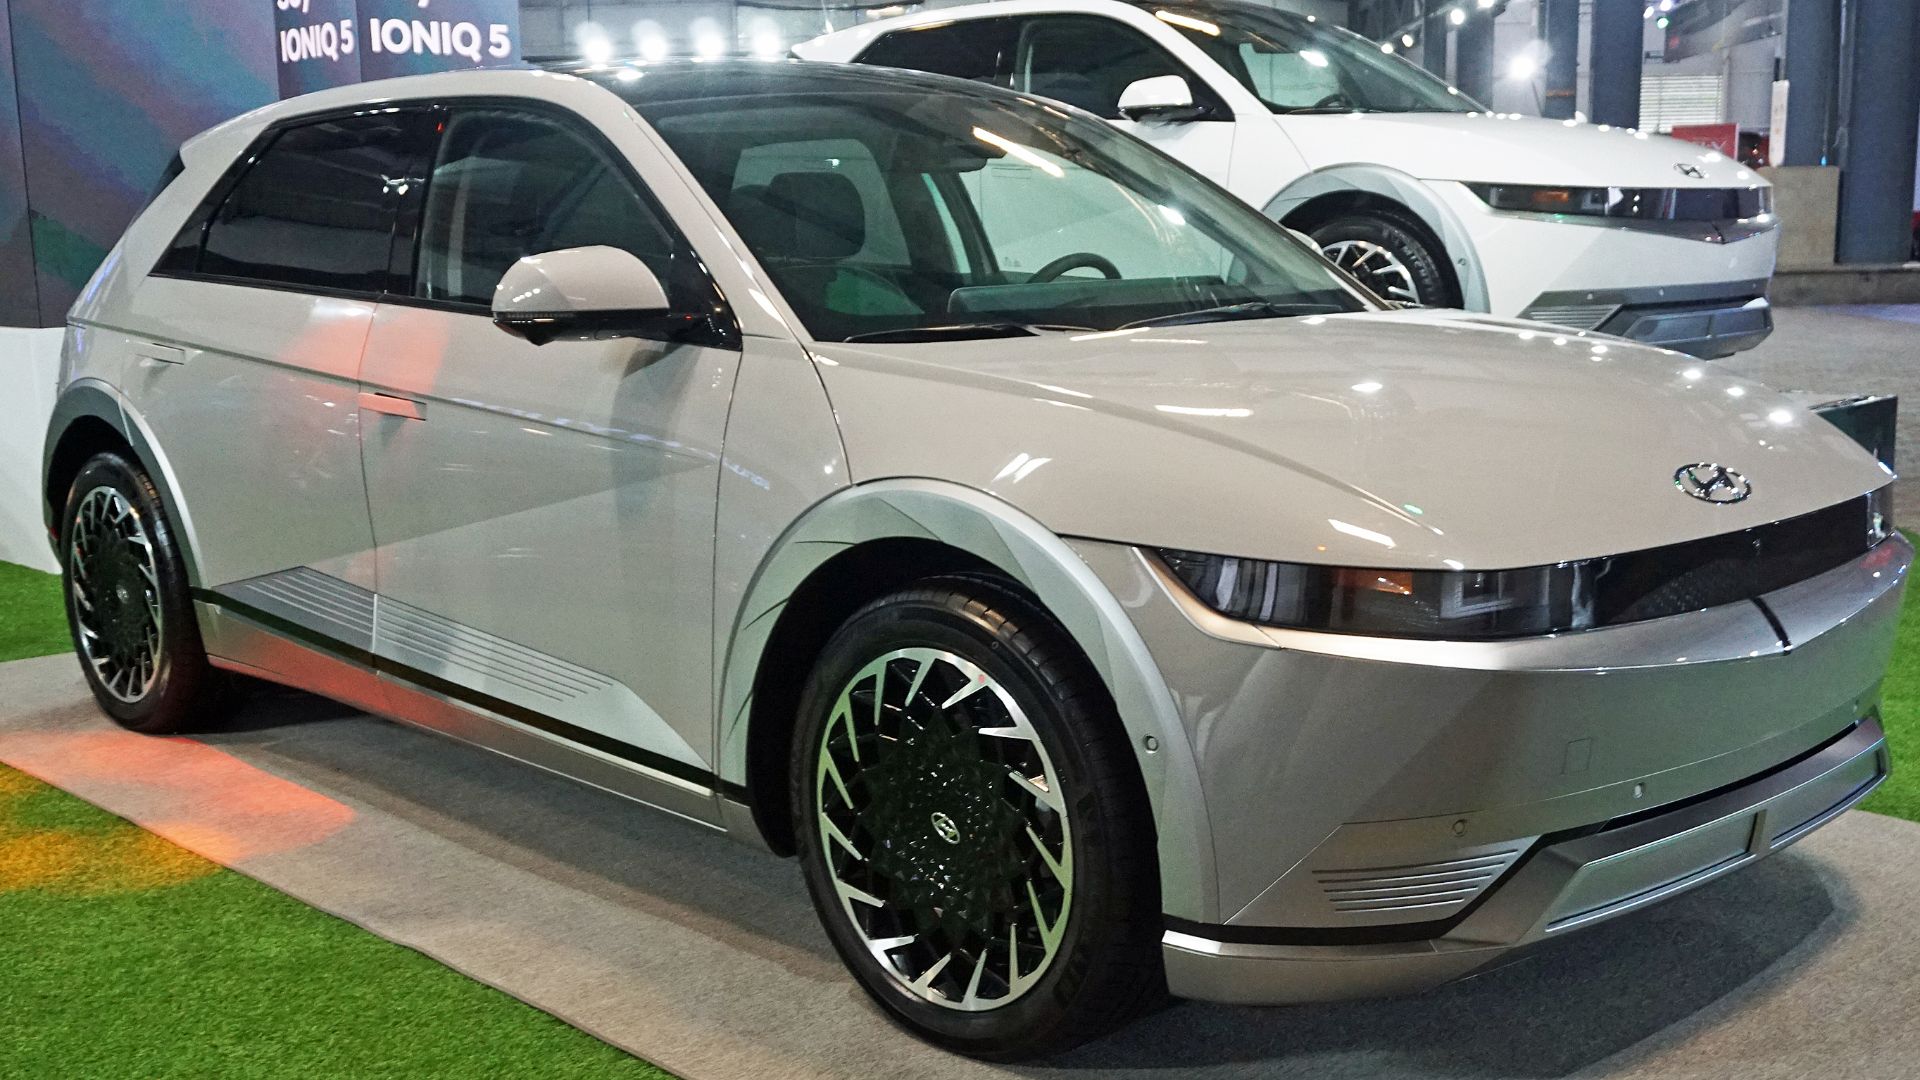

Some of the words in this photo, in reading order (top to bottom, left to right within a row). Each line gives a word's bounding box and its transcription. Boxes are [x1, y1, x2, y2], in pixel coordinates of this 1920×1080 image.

[280, 22, 339, 63] IONIQ
[340, 19, 355, 54] 5
[369, 18, 482, 62] IONIQ
[488, 24, 511, 58] 5
